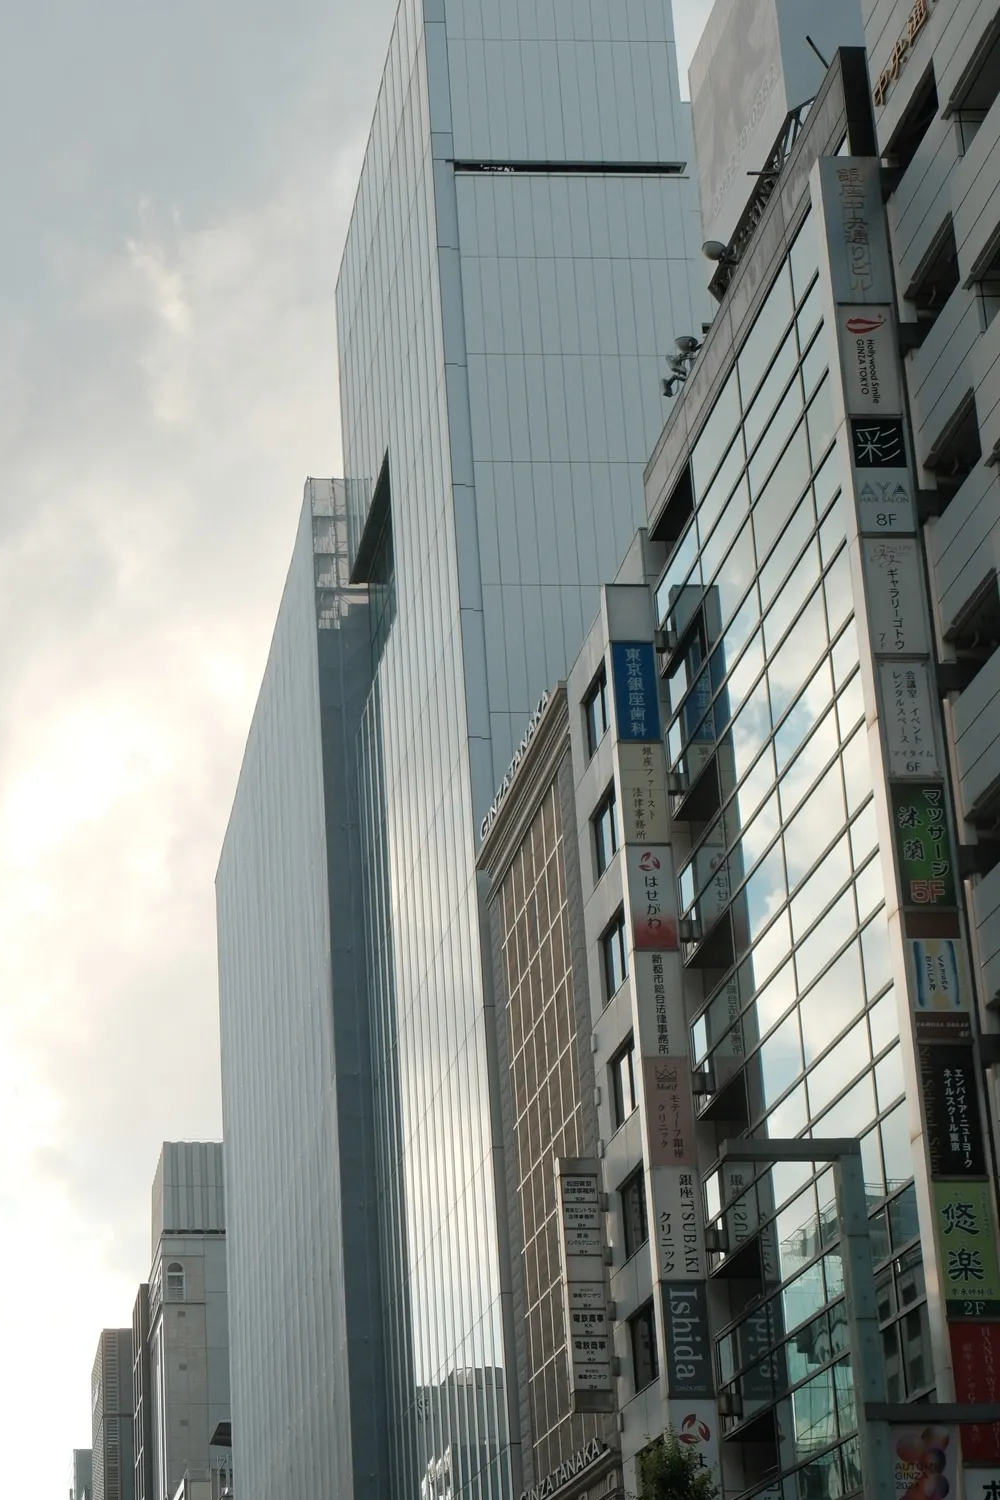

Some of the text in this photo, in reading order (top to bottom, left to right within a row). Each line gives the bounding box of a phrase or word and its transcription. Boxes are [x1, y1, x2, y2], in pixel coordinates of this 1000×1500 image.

[836, 167, 874, 293] 銀座中央通りビル
[856, 339, 870, 395] GINZA TOKYO
[866, 339, 881, 405] Hollywood Smile
[856, 427, 900, 463] 彩
[860, 481, 908, 499] AYA
[876, 513, 898, 526] 8F
[887, 567, 905, 650] ギャラリーゴトウ
[624, 648, 648, 736] 東京銀座歯科
[893, 670, 909, 744] レンタルスペース
[641, 747, 656, 819] 銀座ファースト
[906, 762, 921, 772] 6F
[632, 787, 647, 840] 法律事務所
[922, 789, 949, 878] マッサージ
[644, 876, 662, 930] はせがわ
[910, 880, 945, 904] 5F
[652, 954, 669, 1054] 新都市総合法律事務所
[657, 1104, 668, 1148] クリニック
[670, 1094, 685, 1159] モティーフ銀座
[943, 1068, 960, 1152] ネイルスクール東京
[954, 1069, 972, 1168] エンパイア・ニューヨーク
[660, 1212, 675, 1273] クリニック
[669, 1287, 703, 1380] Ishida
[964, 1301, 986, 1315] 2F
[894, 1472, 928, 1480] GINZA
